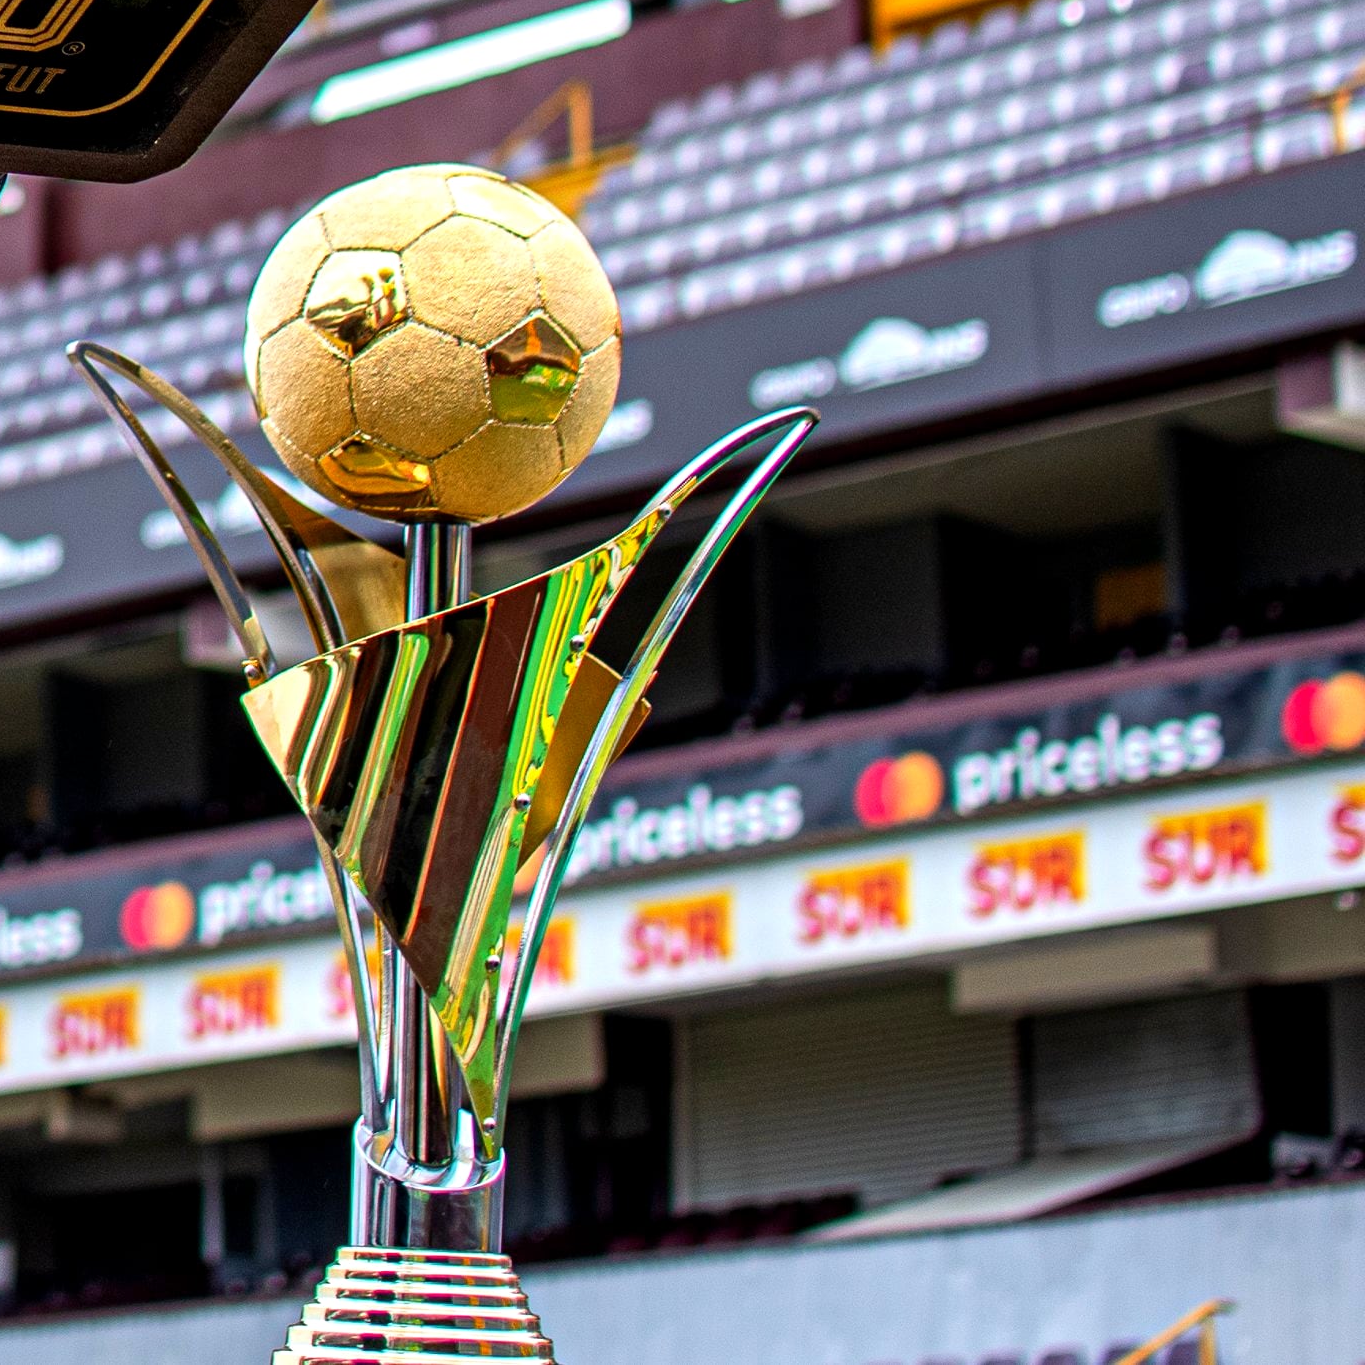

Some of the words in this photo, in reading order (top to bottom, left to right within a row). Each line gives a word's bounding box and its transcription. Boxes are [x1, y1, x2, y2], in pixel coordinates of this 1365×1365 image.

[953, 711, 1225, 816] priceless
[965, 838, 1085, 919] SUR
[1141, 807, 1265, 897] SUR
